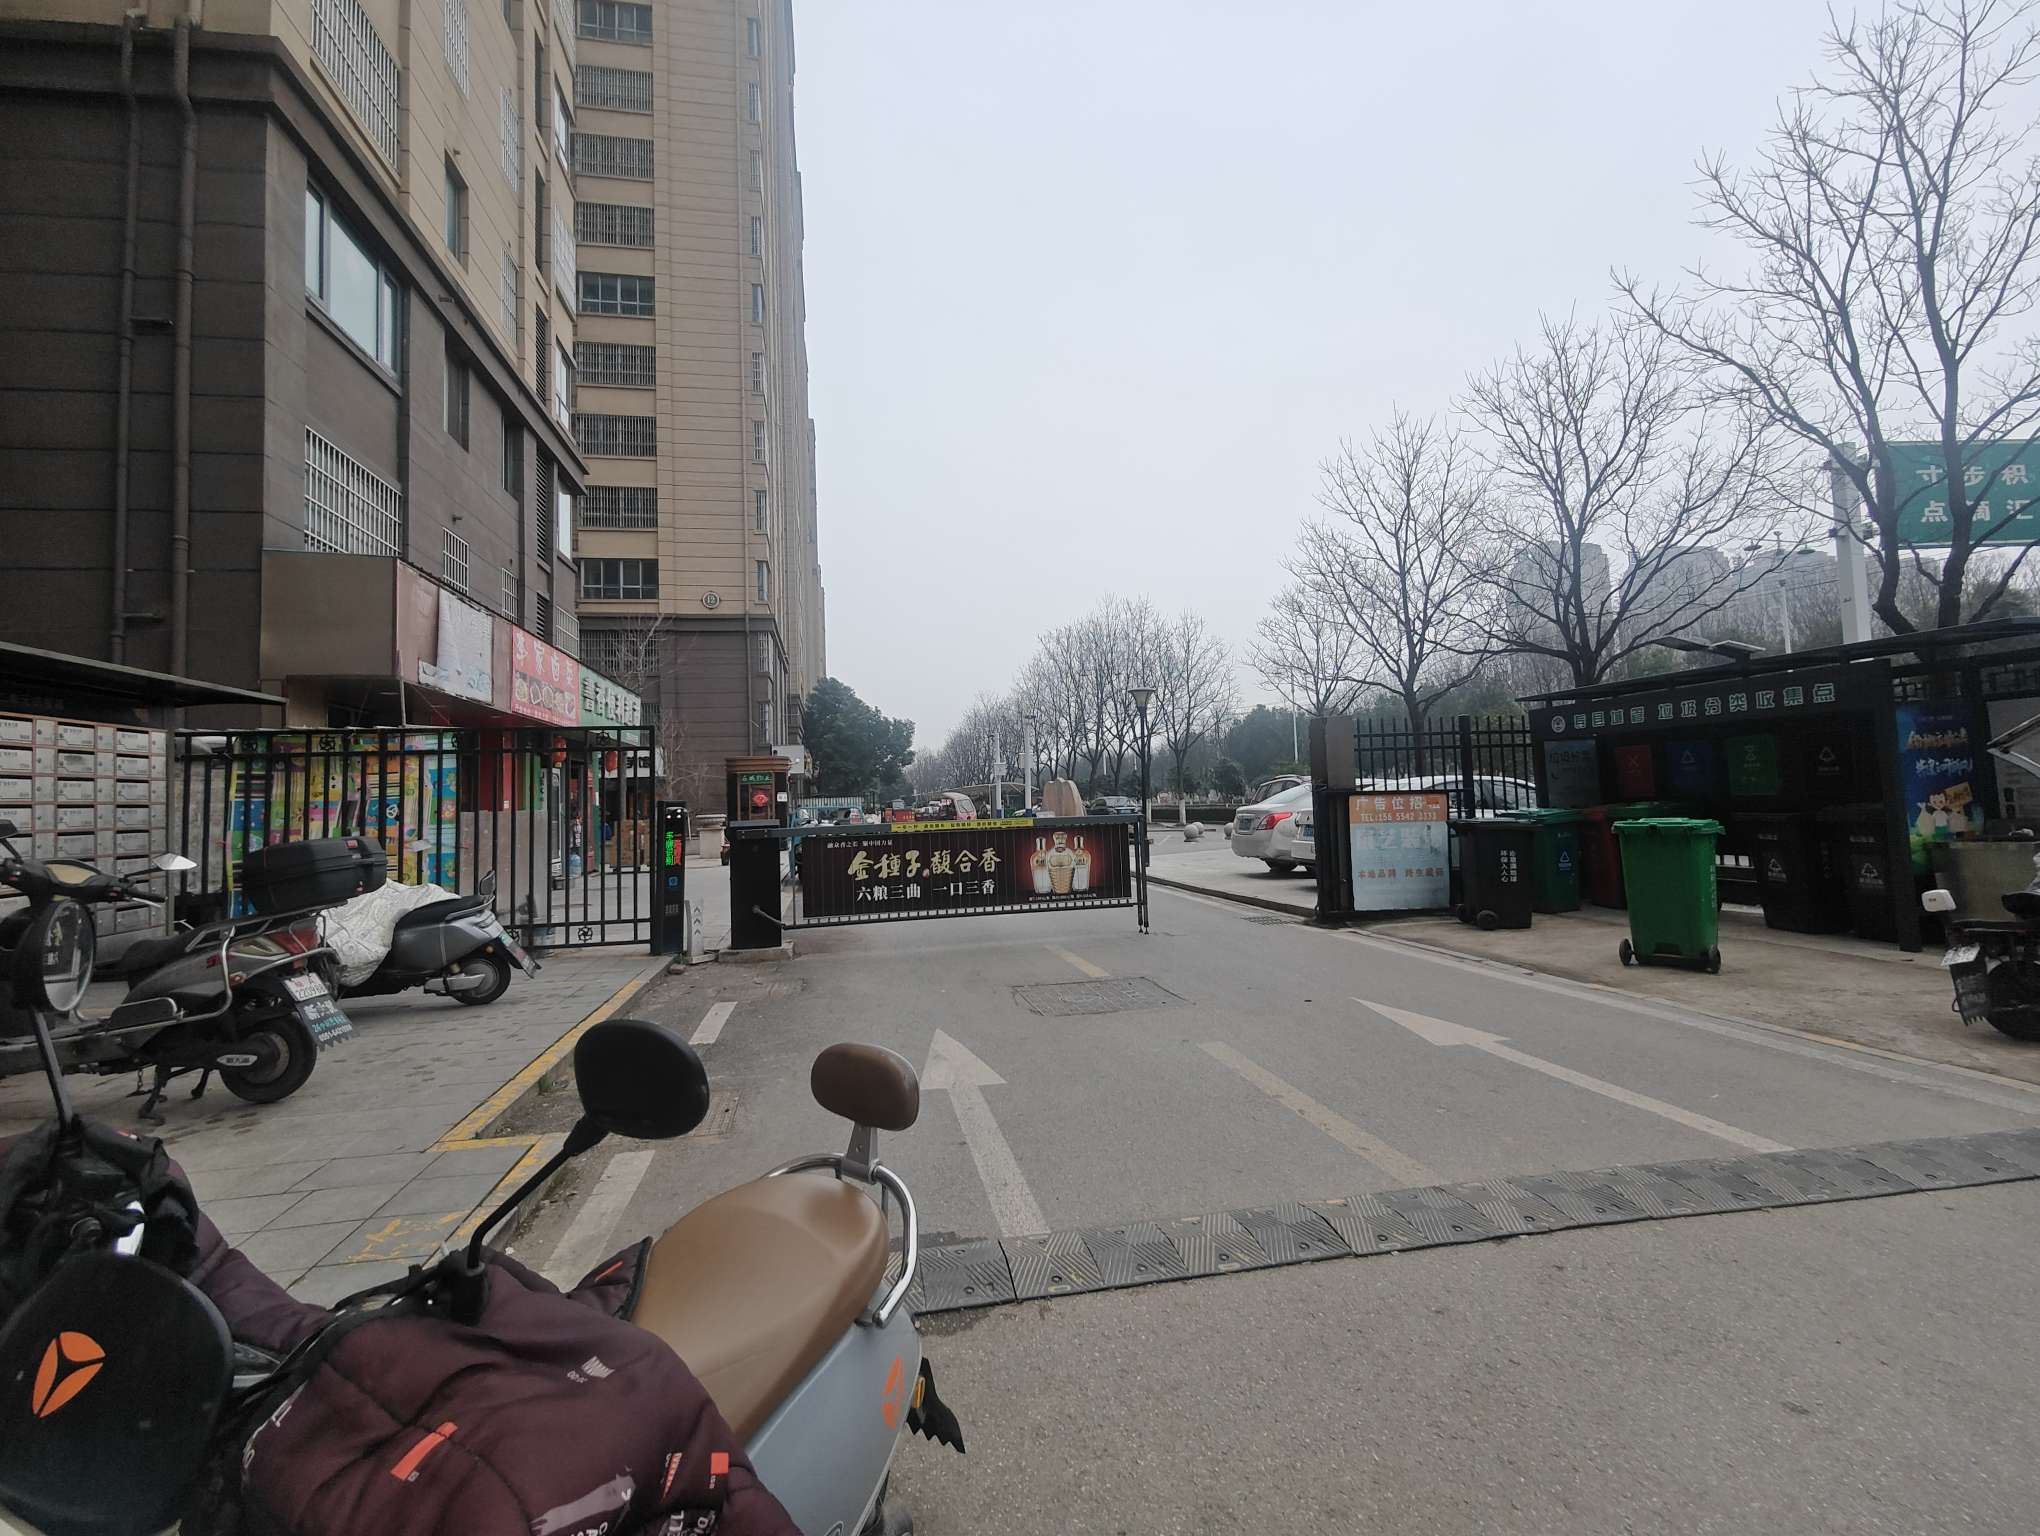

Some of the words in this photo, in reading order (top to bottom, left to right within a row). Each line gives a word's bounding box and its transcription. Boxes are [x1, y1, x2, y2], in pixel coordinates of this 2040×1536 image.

[1657, 682, 1836, 720] 垃圾分类收集点
[930, 846, 1002, 878] 馥合香
[856, 882, 921, 902] 六粮三曲
[932, 880, 996, 897] 一口三香
